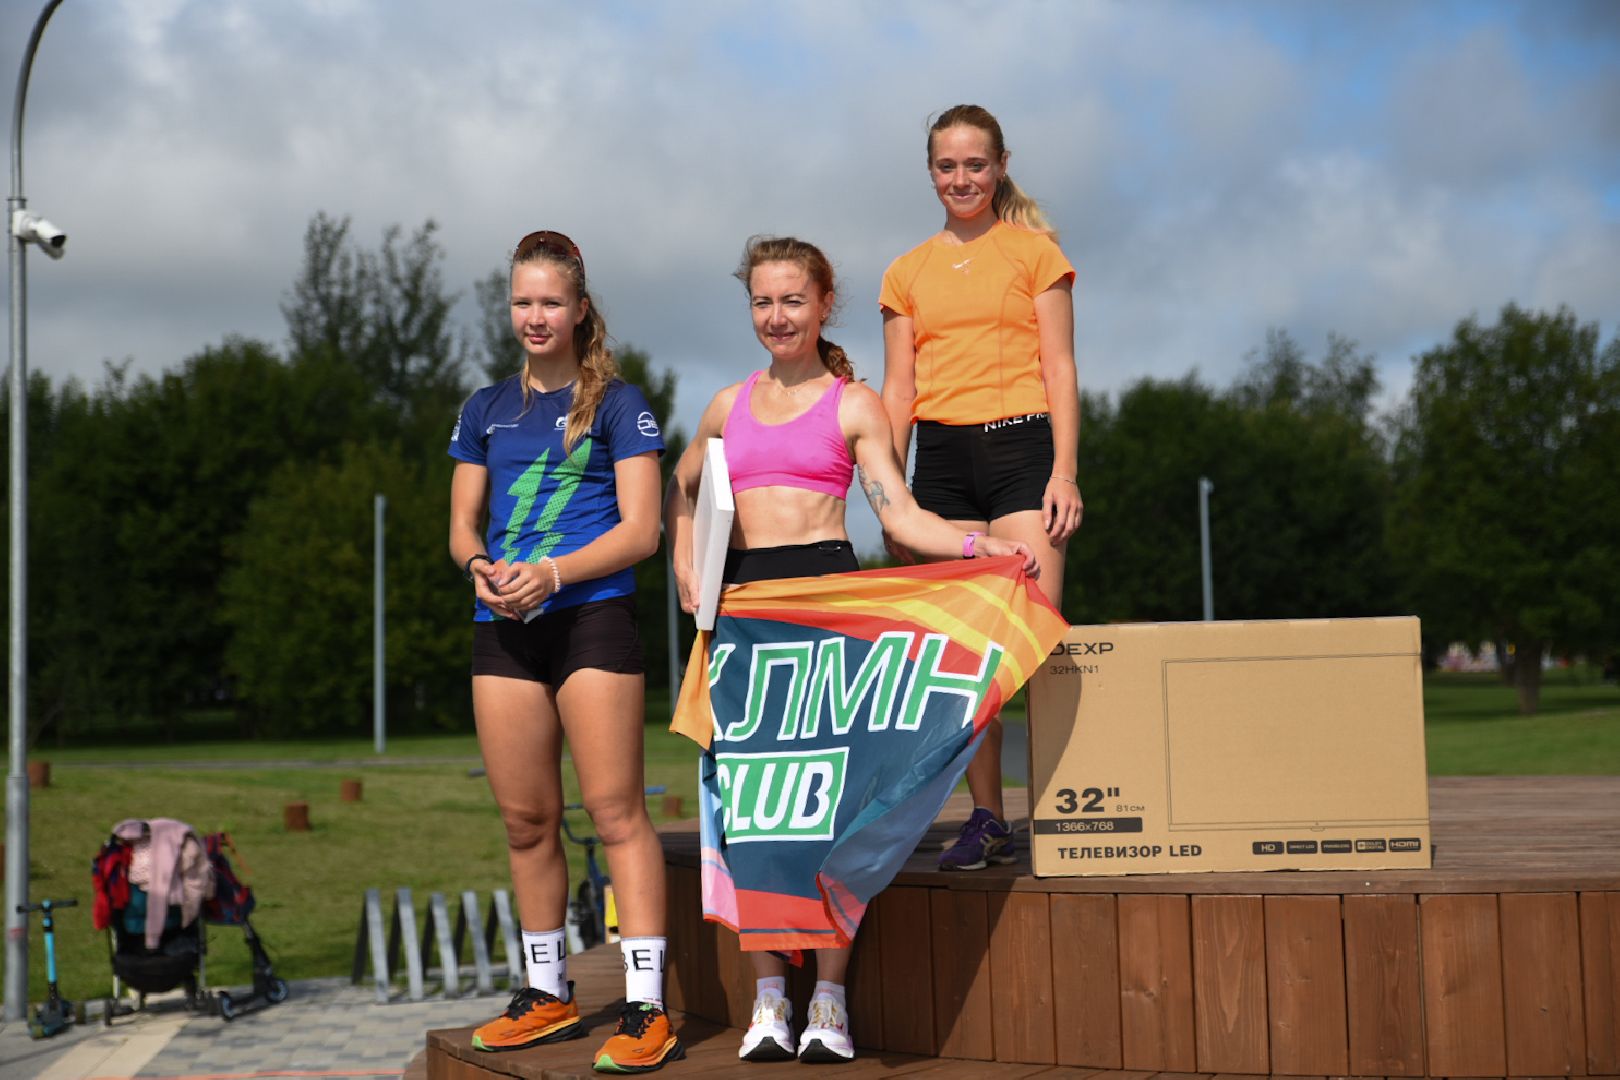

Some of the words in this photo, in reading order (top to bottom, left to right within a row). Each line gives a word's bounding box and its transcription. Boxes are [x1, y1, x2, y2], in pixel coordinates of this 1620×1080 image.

[1049, 642, 1114, 656] DEXP
[1049, 664, 1099, 675] 32HKN1
[1055, 821, 1114, 832] 1366x768
[1057, 845, 1162, 859] ТЕЛЕВИЗОР
[1169, 844, 1203, 858] LED
[1261, 843, 1276, 853] HD
